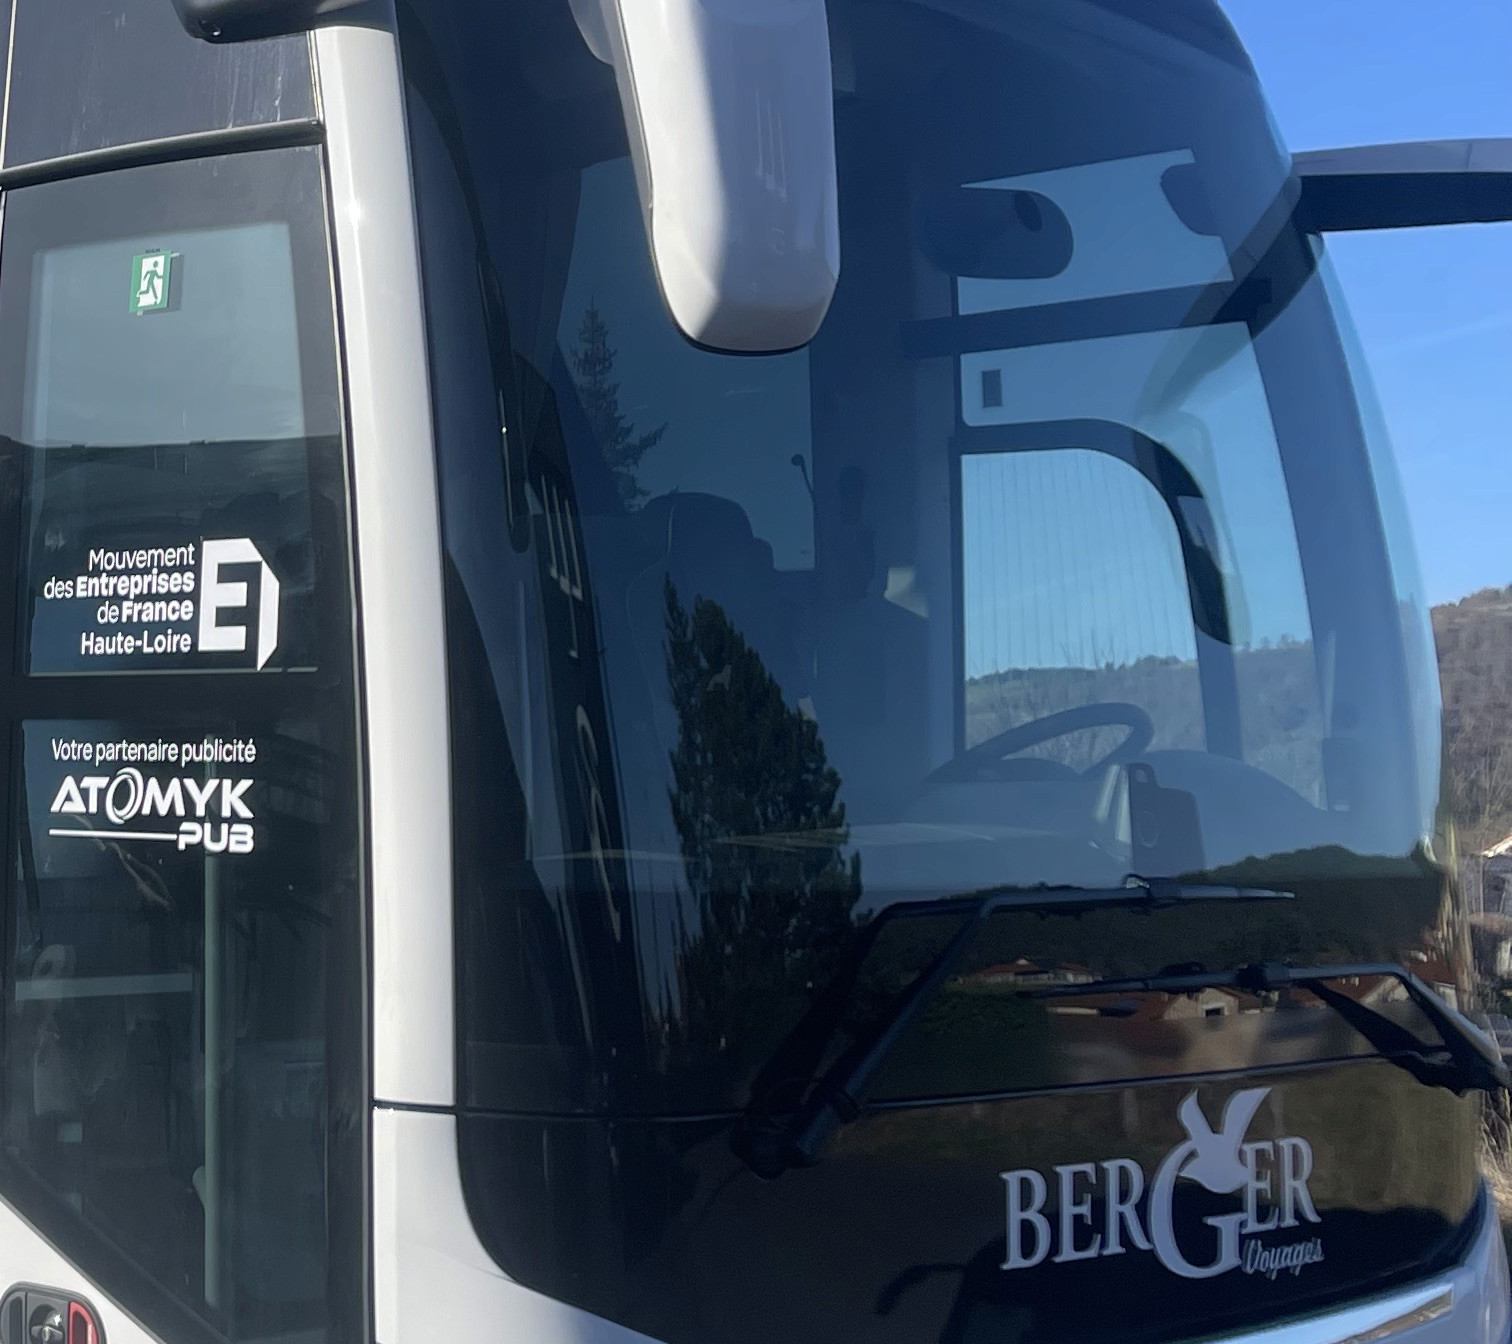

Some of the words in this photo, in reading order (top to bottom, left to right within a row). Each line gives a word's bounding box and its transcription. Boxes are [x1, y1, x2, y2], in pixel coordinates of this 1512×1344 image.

[89, 543, 195, 571] Mouvement
[44, 577, 74, 599] des
[76, 570, 195, 603] Entreprises
[97, 601, 119, 624] de
[122, 599, 194, 624] France
[81, 629, 192, 655] Haute-Loire
[52, 739, 93, 761] Votre
[96, 739, 179, 767] partenaire
[182, 738, 257, 767] publicité
[50, 767, 255, 824] ATOMYK
[177, 822, 255, 853] PUB
[999, 1134, 1322, 1279] BERGER
[1238, 1237, 1325, 1281] Voyages
